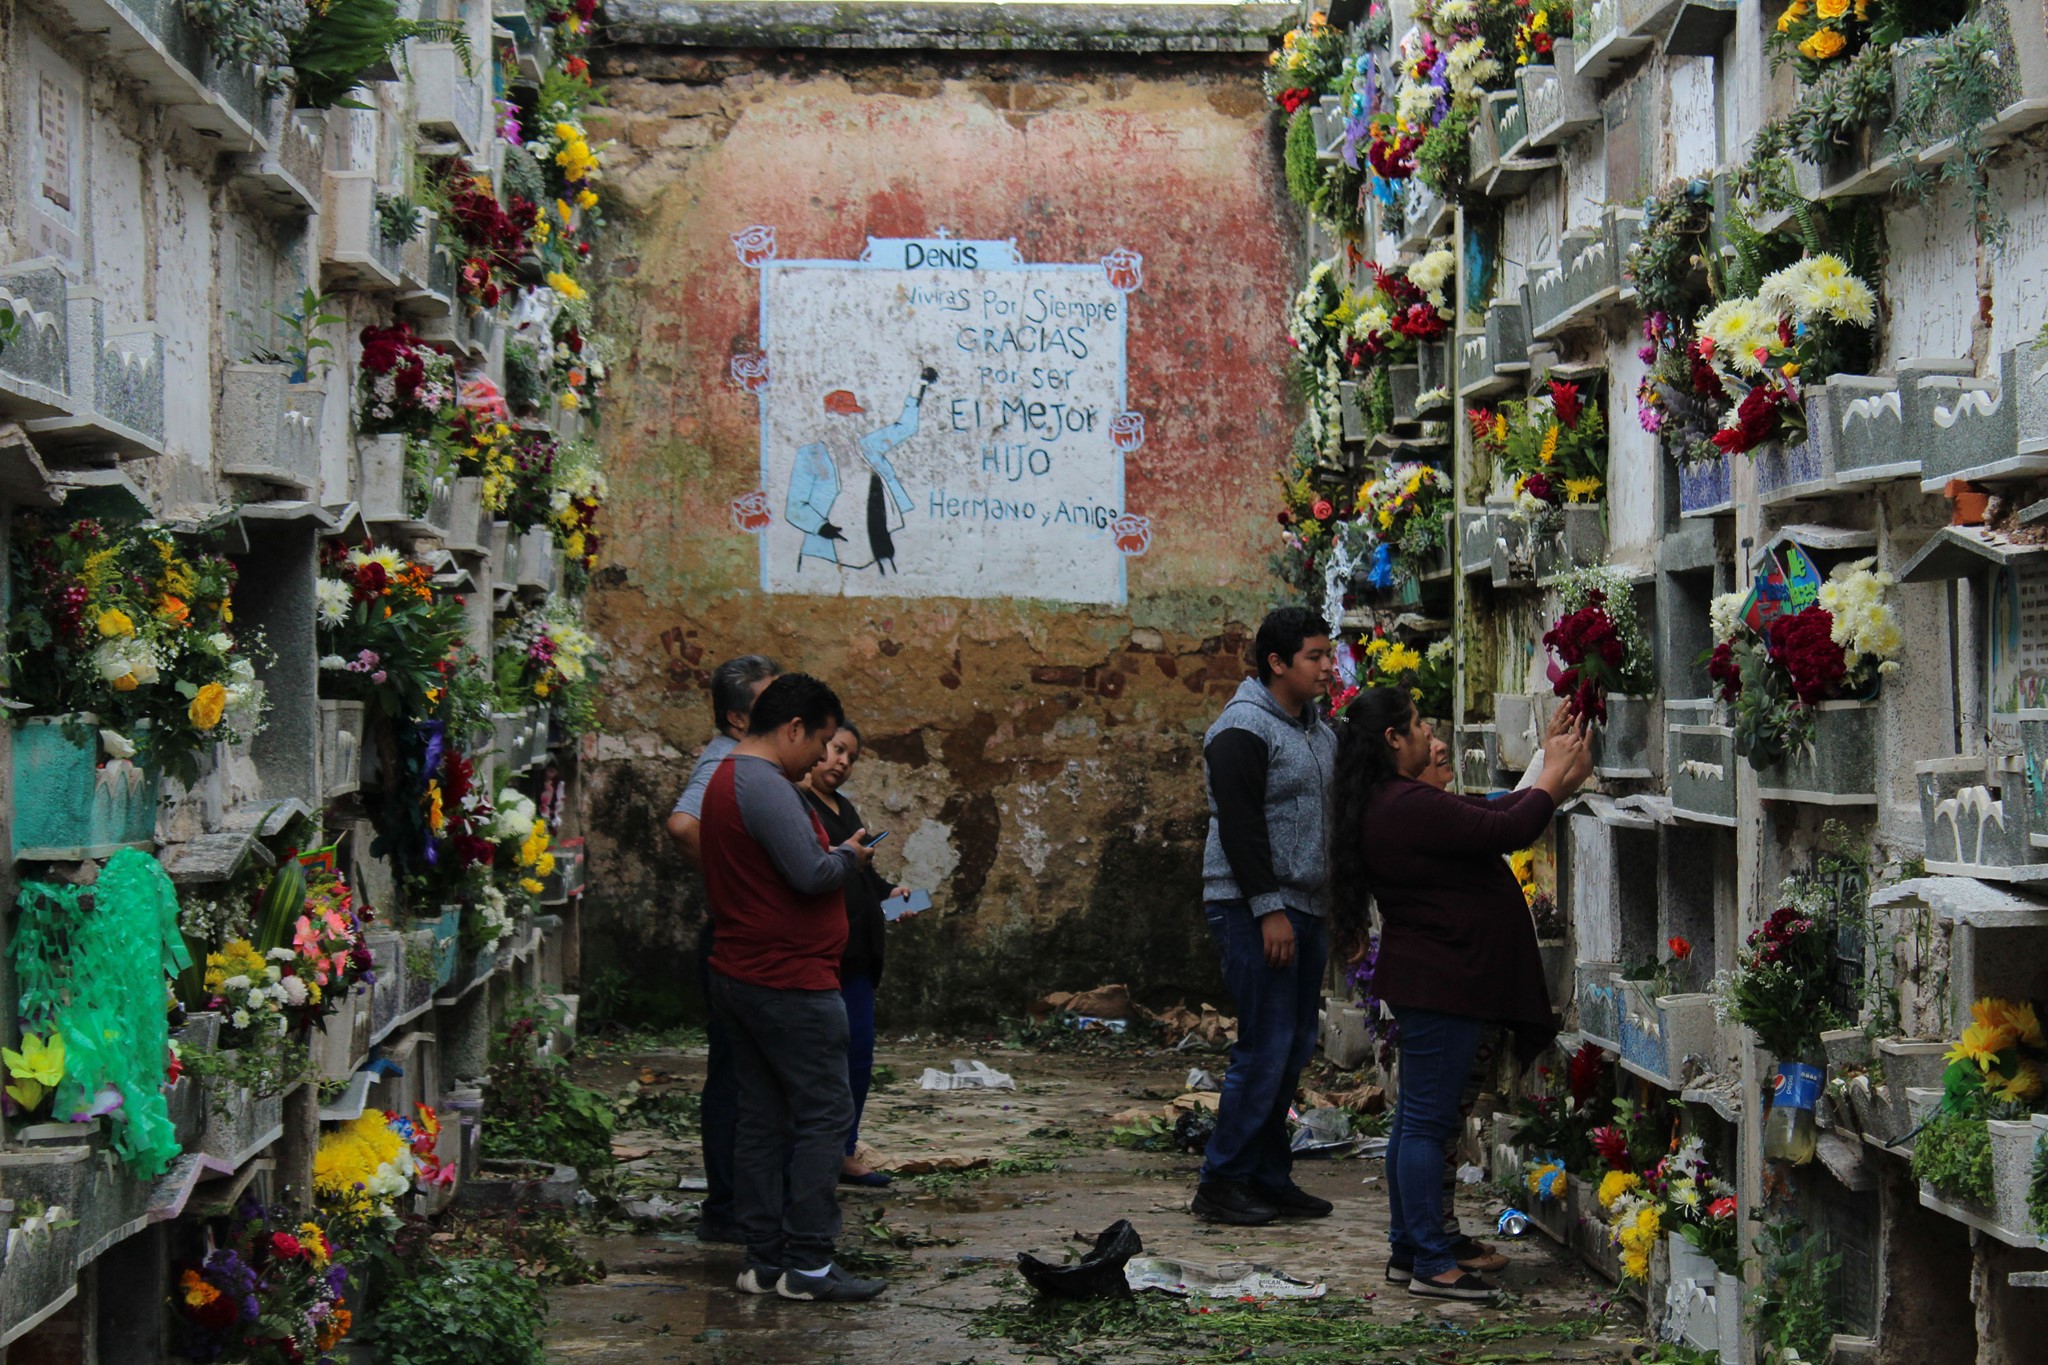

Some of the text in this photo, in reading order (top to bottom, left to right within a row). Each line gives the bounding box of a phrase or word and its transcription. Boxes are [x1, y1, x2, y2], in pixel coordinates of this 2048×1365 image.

[1026, 289, 1117, 327] Siempre
[956, 325, 1088, 359] GRACIAS
[951, 399, 980, 431] El
[981, 443, 1050, 482] HIJO
[1787, 549, 1806, 577] Me
